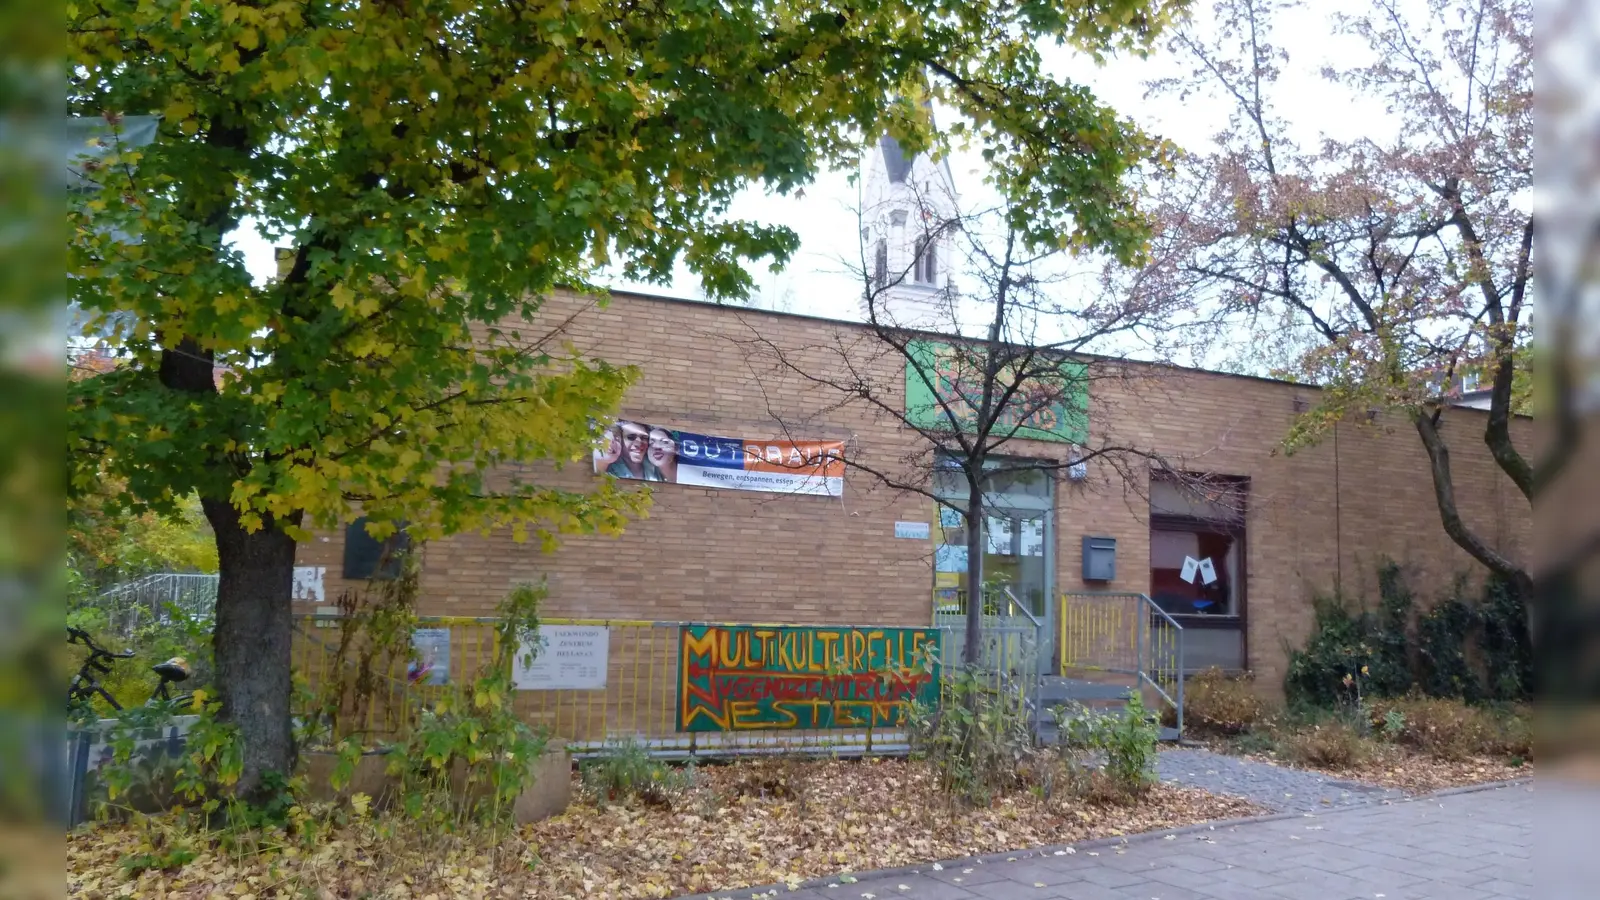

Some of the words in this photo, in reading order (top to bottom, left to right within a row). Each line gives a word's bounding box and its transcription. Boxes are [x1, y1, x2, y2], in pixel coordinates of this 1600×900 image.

[683, 439, 740, 461] GUT
[745, 445, 841, 468] DRAUF
[702, 470, 735, 481] Bewegen,
[736, 474, 775, 484] entspannen,
